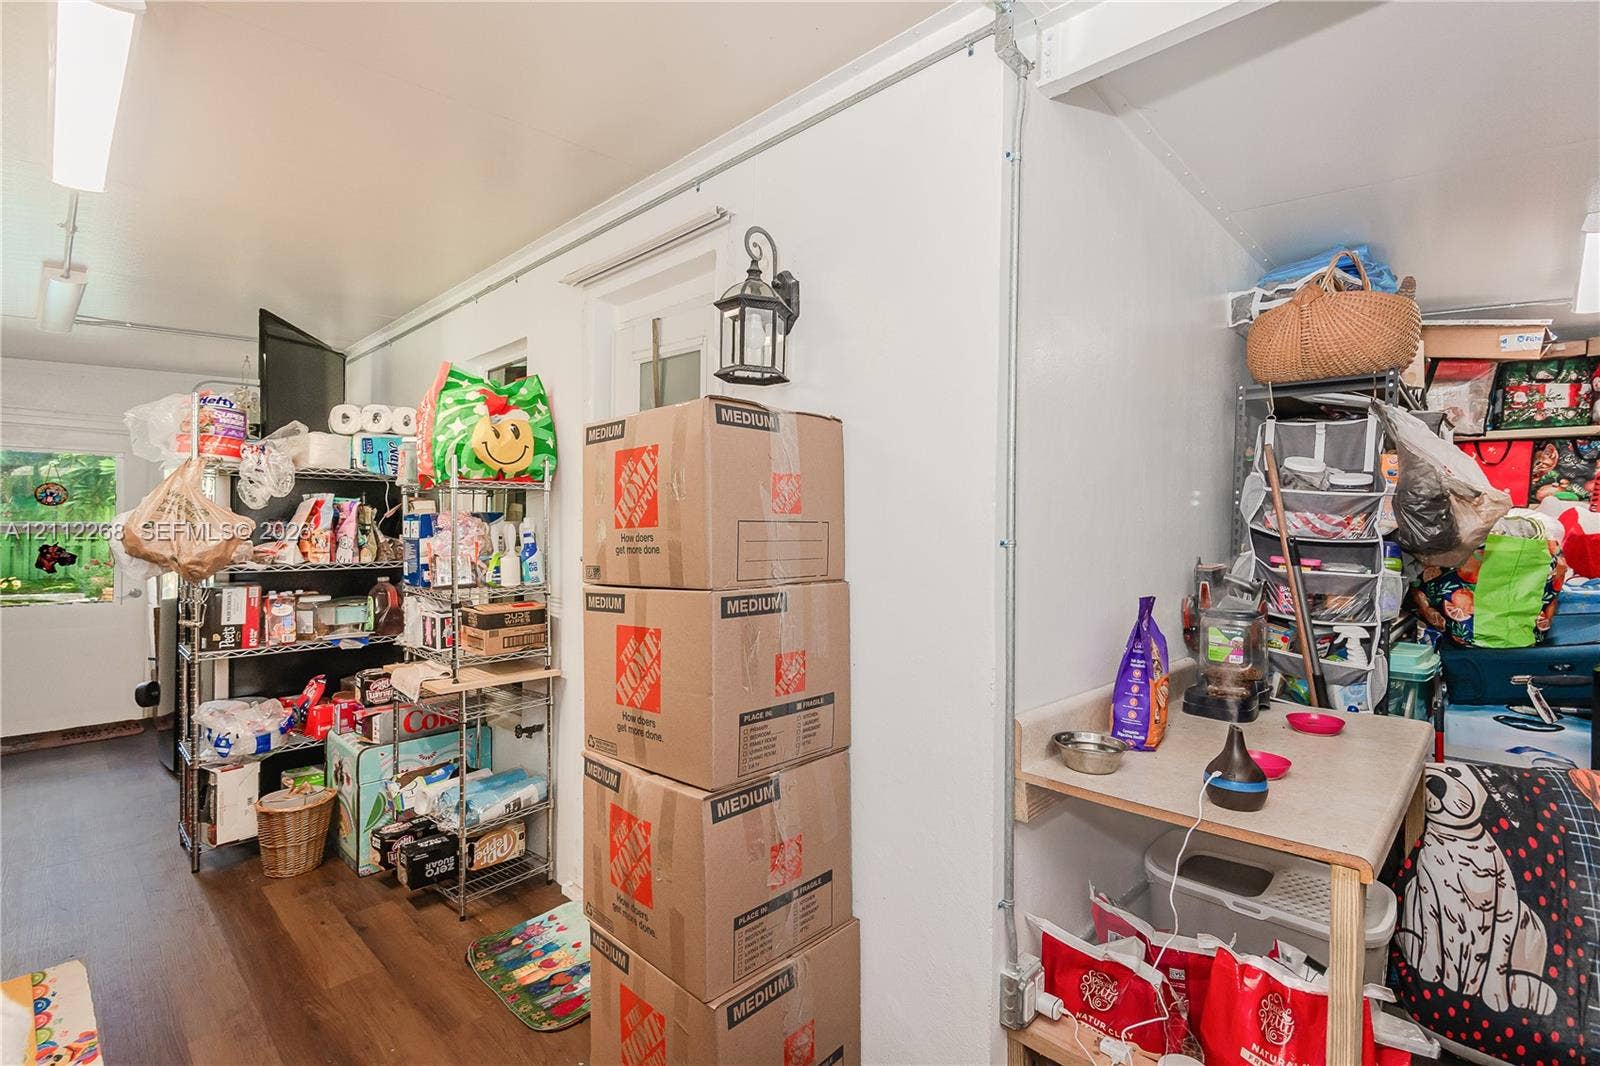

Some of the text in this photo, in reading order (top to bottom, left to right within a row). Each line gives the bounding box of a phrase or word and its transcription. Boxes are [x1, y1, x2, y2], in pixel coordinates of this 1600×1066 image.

[721, 406, 776, 429] MEDIUM
[588, 424, 622, 443] MEDIUM
[615, 445, 659, 529] HOME
[620, 533, 654, 543] How doers
[615, 546, 626, 556] get
[627, 546, 642, 555] more
[588, 595, 622, 610] MEDIUM
[727, 594, 784, 615] MEDIUM
[620, 635, 638, 662] THE
[616, 627, 661, 706] HOME
[632, 656, 661, 709] DEPOT
[622, 712, 656, 728] How doers
[616, 722, 664, 743] get more done.
[586, 762, 618, 788] MEDIUM
[717, 785, 776, 818] MEDIUM
[425, 861, 455, 878] zero
[426, 856, 455, 870] SUGAR
[800, 877, 823, 895] FRAGILE
[612, 903, 623, 917] get
[623, 908, 638, 925] more
[616, 892, 631, 908] How
[631, 906, 649, 922] doers
[738, 911, 759, 925] PLACE
[591, 932, 627, 969] MEDIUM
[733, 977, 791, 1022] MEDIUM
[1080, 982, 1119, 1011] Kitty
[1076, 1012, 1107, 1031] NATUR
